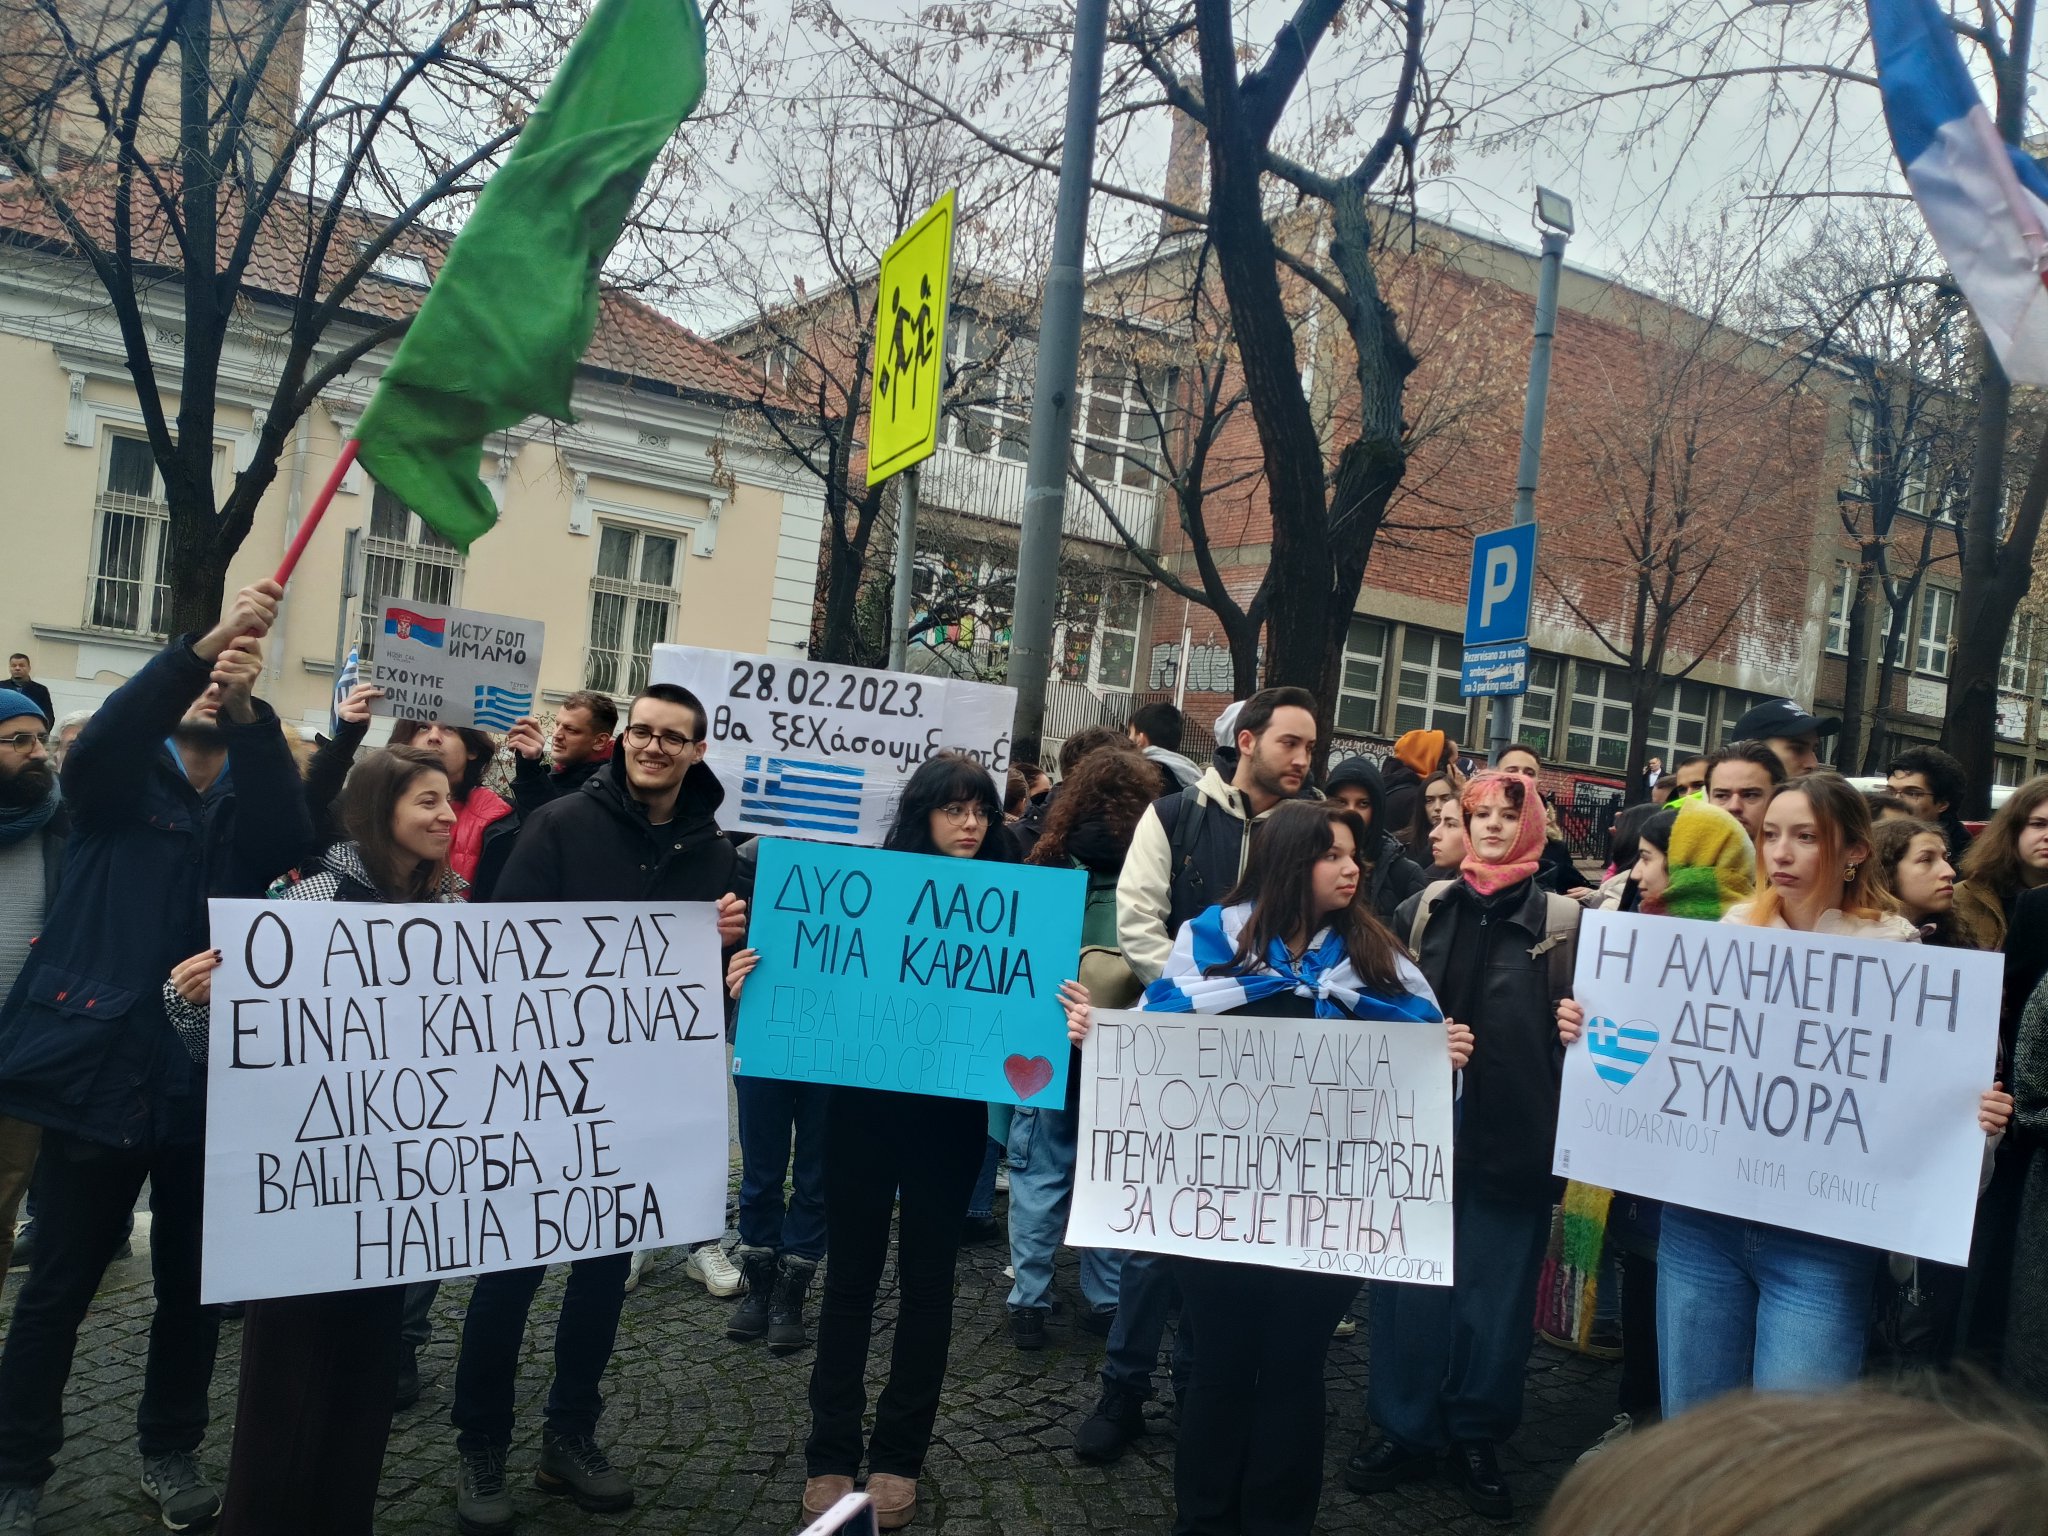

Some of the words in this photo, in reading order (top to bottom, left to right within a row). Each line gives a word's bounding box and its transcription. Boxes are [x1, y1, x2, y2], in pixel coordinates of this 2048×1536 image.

[1480, 545, 1517, 627] P
[449, 640, 526, 664] ИМАМО
[450, 621, 493, 641] ИСТУ
[496, 629, 525, 648] БОЛ
[1464, 651, 1498, 662] Rezervisano
[1499, 651, 1507, 659] za
[1508, 647, 1525, 658] vozila
[376, 666, 445, 689] ΕΧΟΥΜΕ
[413, 691, 443, 707] ΙΔΙΟ
[729, 660, 924, 718] 28.02.2023.
[1472, 681, 1478, 692] 3
[1477, 680, 1499, 694] parking
[1500, 681, 1520, 690] mesta
[392, 703, 438, 721] ΠΟΝΟ
[774, 864, 873, 919] ΔΥΟ
[907, 879, 1019, 937] ΛΑΟΙ
[244, 910, 293, 989] Ο
[322, 917, 570, 987] ΑΓΩΝΑΣ
[583, 913, 681, 978] ΣΑΣ
[793, 920, 868, 978] ΜΙΑ
[899, 935, 1035, 998] ΚΑΡΔΙΑ
[1595, 925, 1638, 983] Η
[1658, 933, 1961, 1033] ΑΛΛΗΛΕΓΓΥΗ
[229, 997, 391, 1068] ΕΙΝΑΙ
[420, 993, 498, 1058] ΚΑΙ
[512, 983, 719, 1052] ΑΓΩΝΑΣ
[766, 985, 839, 1037] ДВА
[1671, 1000, 1765, 1059] ΔΕΝ
[1794, 1019, 1893, 1083] ΕΧΕΙ
[768, 1035, 887, 1079] ЈЕДНО
[898, 1046, 989, 1097] СРЦЕ
[1096, 1023, 1185, 1076] ΠΡΟΣ
[1198, 1027, 1276, 1082] ΕΝΑΝ
[1290, 1032, 1394, 1088] ΑΔΙΚΙΑ
[295, 1067, 467, 1142] ΔΙΚΟΣ
[481, 1057, 606, 1124] ΜΑΣ
[1095, 1077, 1148, 1129] ΓΙΑ
[1158, 1078, 1296, 1136] ΟΛΟΥΣ
[1582, 1098, 1721, 1156] SOLIDARNOST
[1660, 1056, 1869, 1153] ΣΥΝΟΡΑ
[254, 1142, 386, 1214] ВАША
[392, 1131, 543, 1200] БОРБА
[562, 1120, 621, 1181] ЈЕ
[1091, 1129, 1179, 1185] ПРЕМА
[1187, 1132, 1321, 1194] ЈЕДНОМЕ
[1327, 1140, 1447, 1202] НЕПРАВДА
[1737, 1157, 1786, 1191] NEMA
[1807, 1170, 1880, 1211] GRANICE
[354, 1198, 512, 1280] НАША
[531, 1182, 664, 1260] БОРБА
[1107, 1184, 1156, 1236] ЗА
